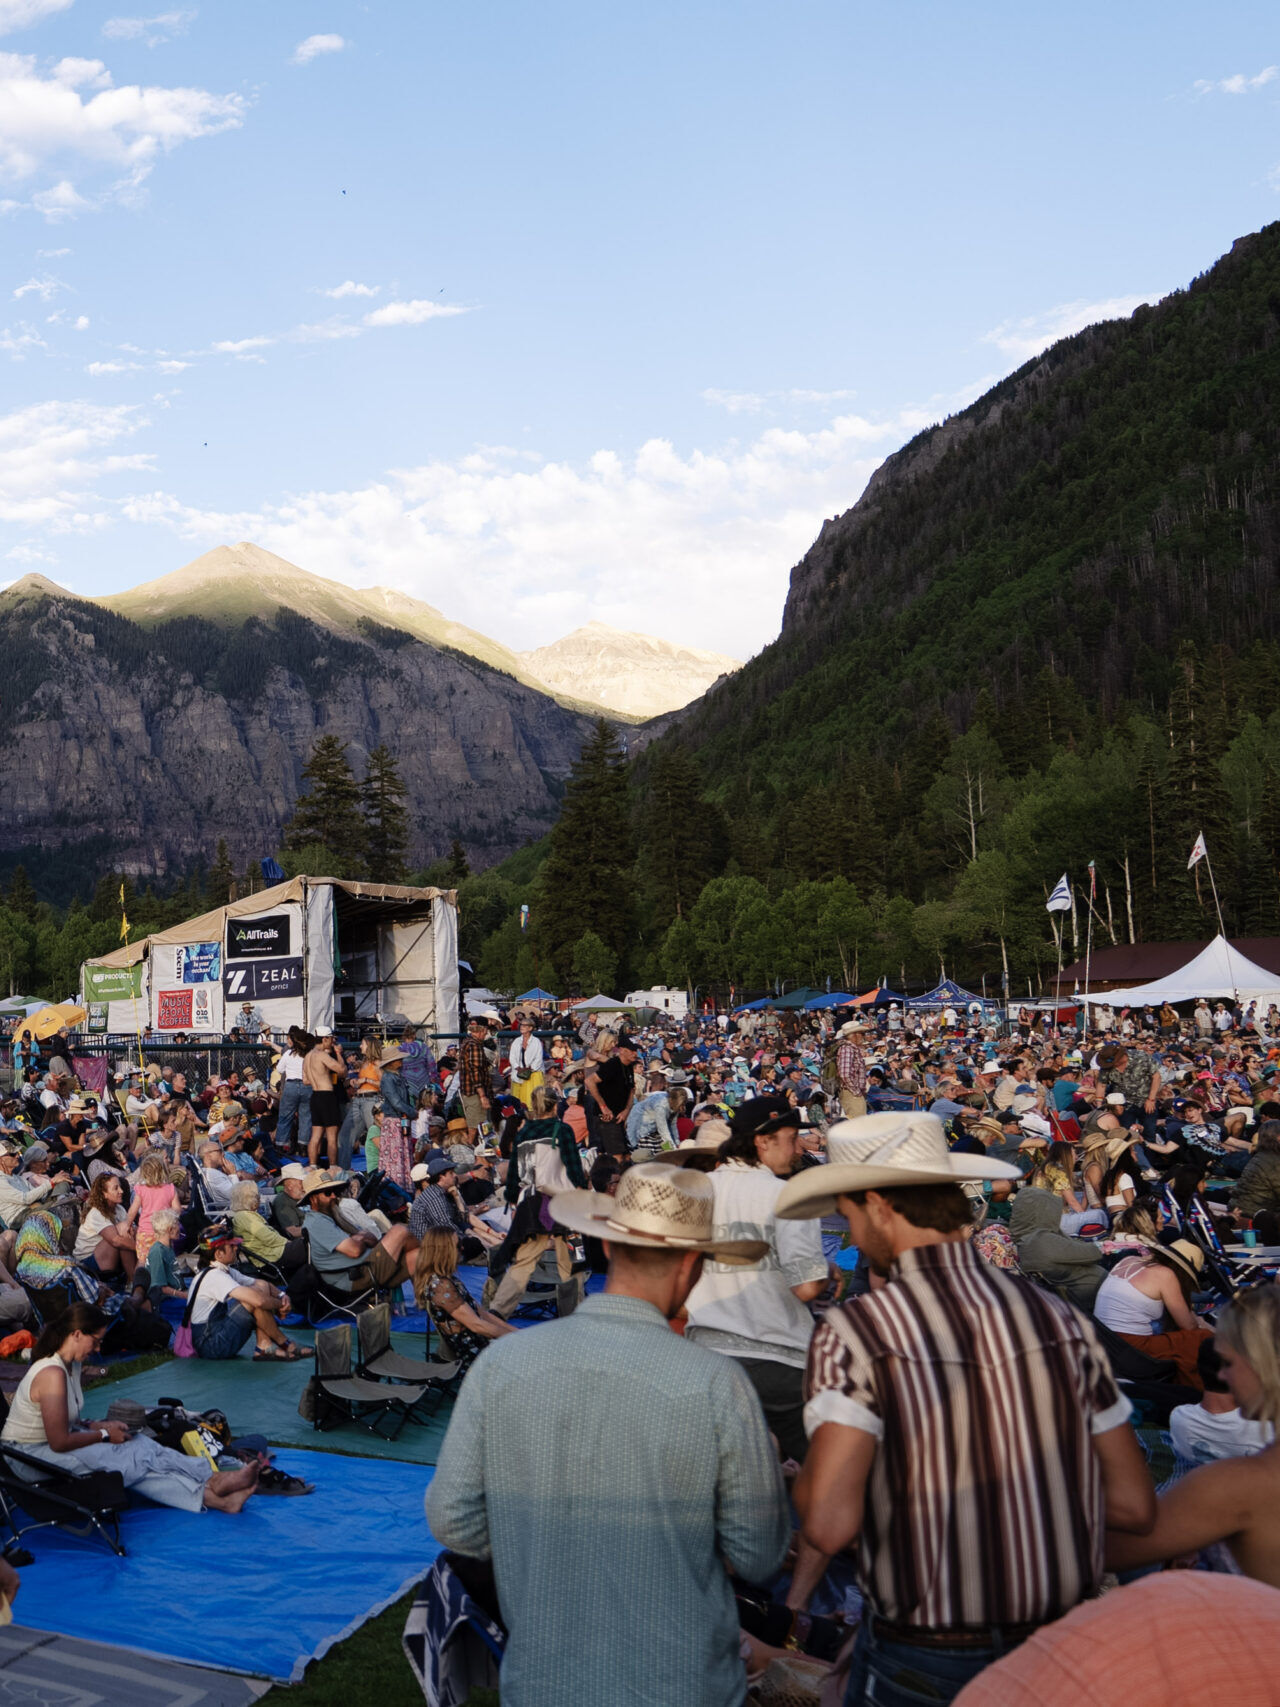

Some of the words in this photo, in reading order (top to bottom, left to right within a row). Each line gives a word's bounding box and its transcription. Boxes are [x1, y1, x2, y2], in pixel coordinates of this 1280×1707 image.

[246, 928, 279, 940] AllTrails
[261, 967, 297, 983] ZEAL
[270, 983, 289, 991] OPTICS
[161, 995, 191, 1007] MUSIC
[160, 1007, 190, 1017] PEOPLE
